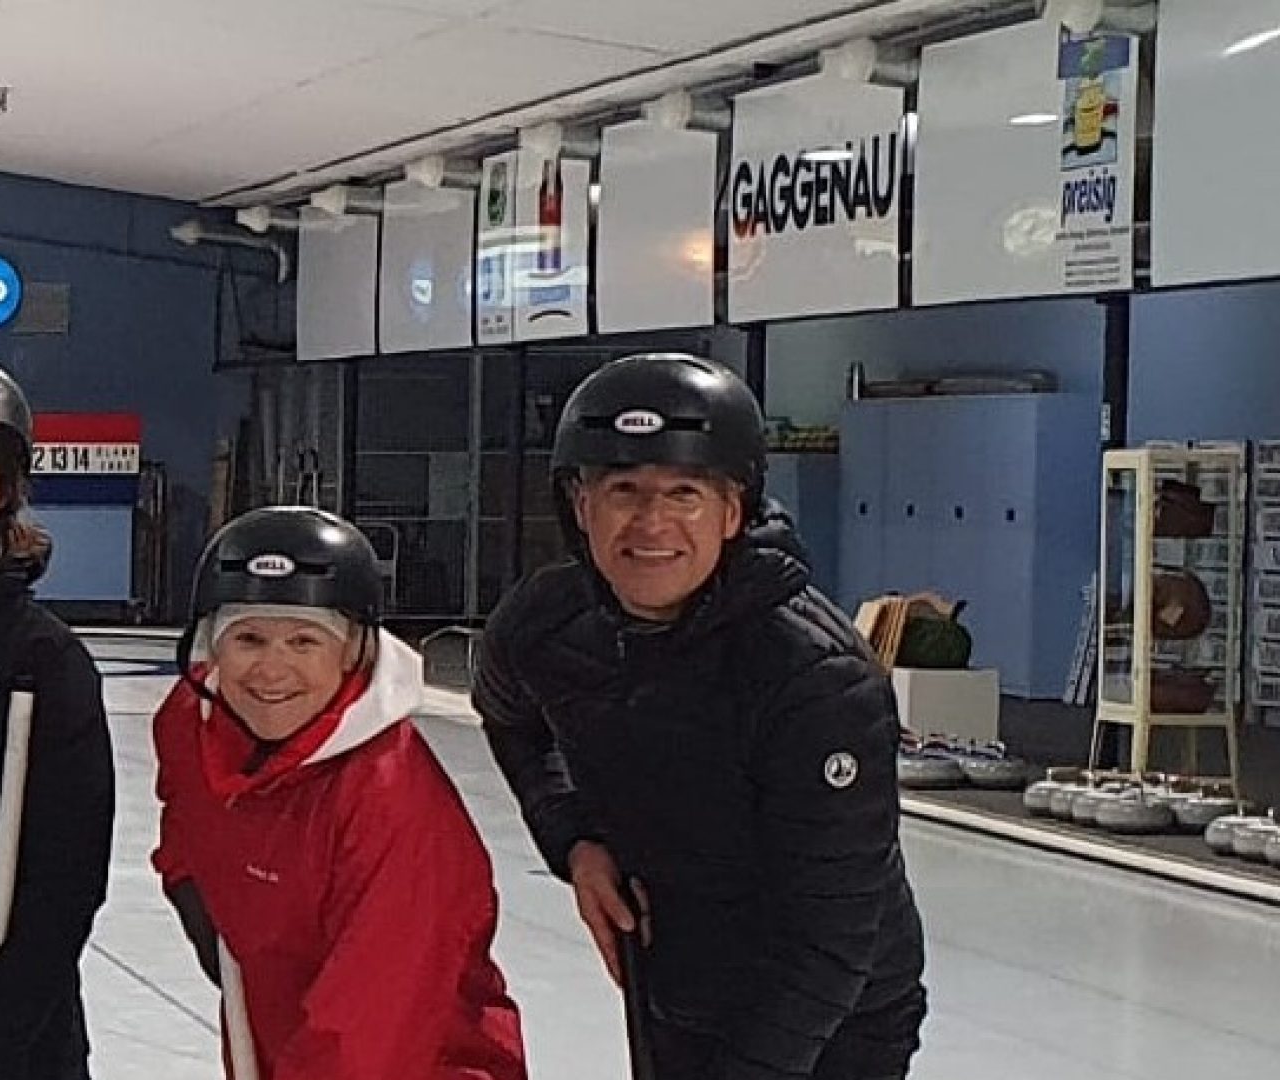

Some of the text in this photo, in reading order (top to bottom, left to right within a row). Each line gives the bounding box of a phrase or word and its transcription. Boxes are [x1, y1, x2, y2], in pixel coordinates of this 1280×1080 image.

[733, 132, 897, 238] GAGGENAU
[1061, 167, 1117, 229] preisig
[621, 416, 655, 427] BELL
[33, 446, 90, 471] 2 13 14
